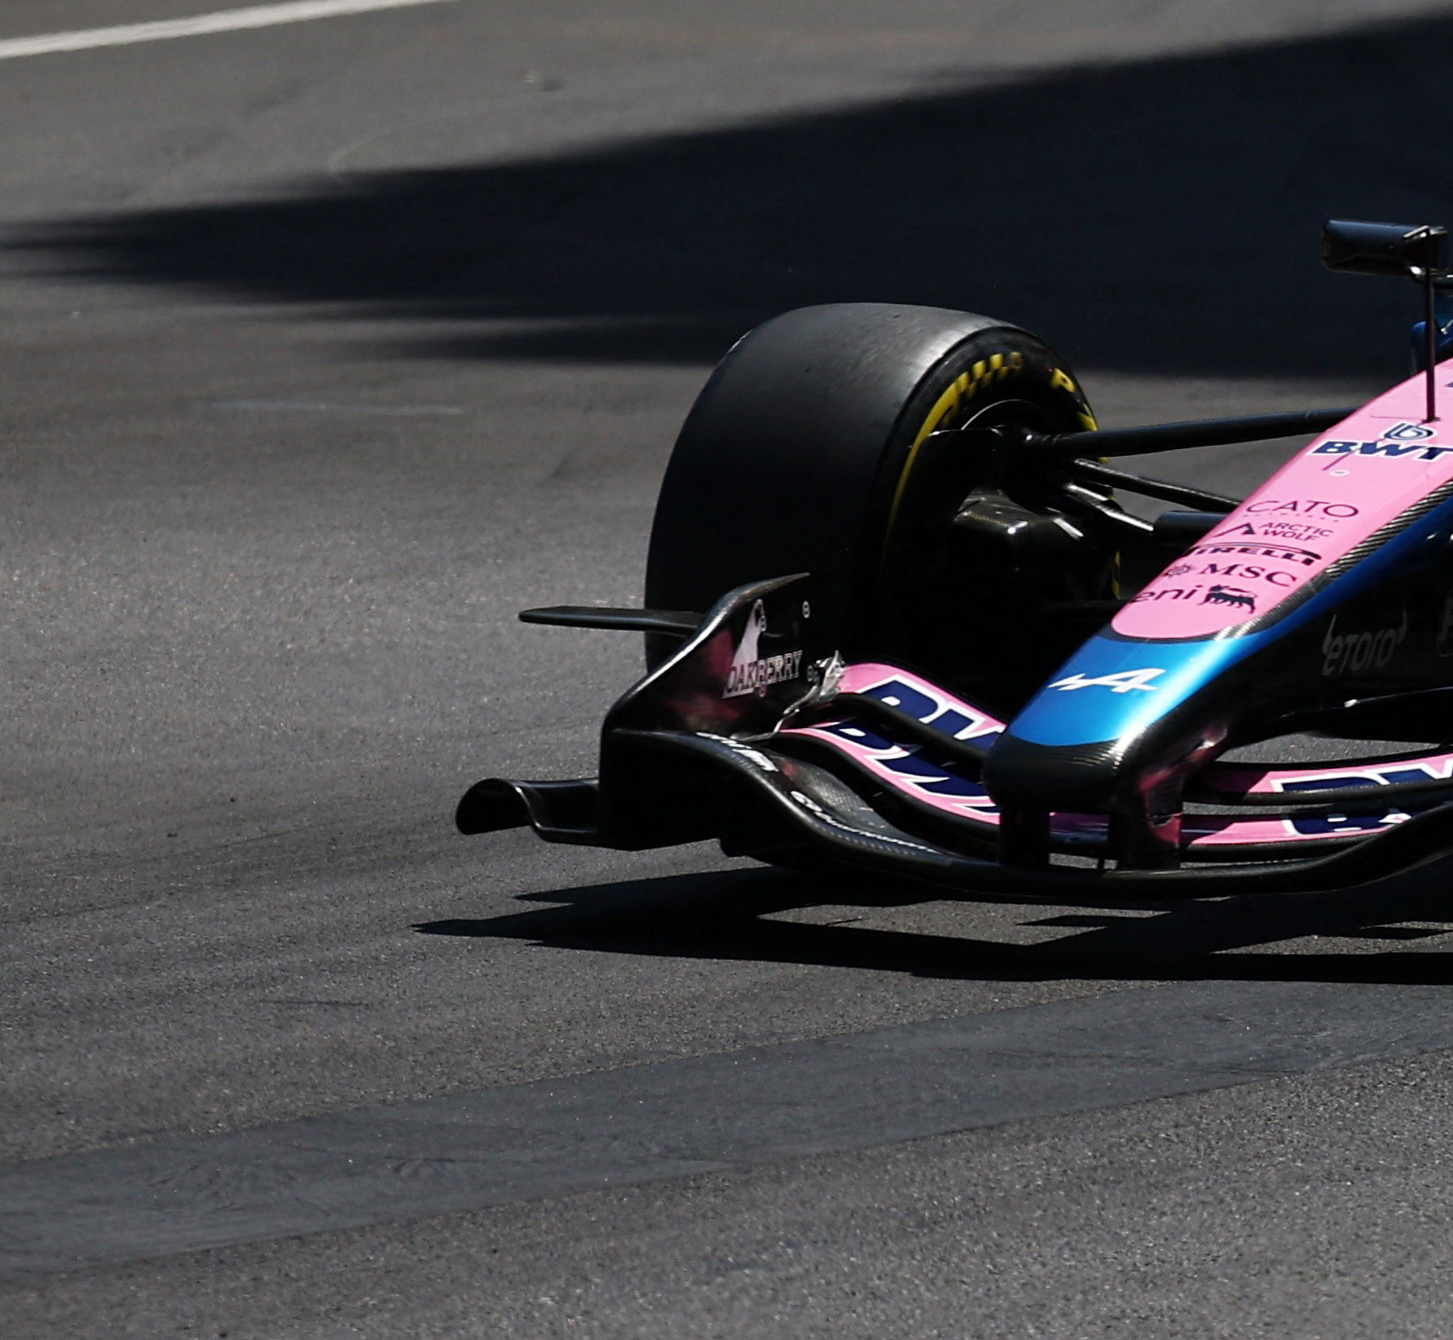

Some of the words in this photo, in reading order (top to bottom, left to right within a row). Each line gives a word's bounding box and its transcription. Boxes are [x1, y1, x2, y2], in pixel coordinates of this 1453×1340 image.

[1245, 499, 1360, 518] CATO
[1260, 521, 1334, 537] ARCTIC
[1262, 529, 1320, 542] WOLF
[1199, 563, 1298, 588] MSC
[1131, 584, 1204, 604] eni
[727, 649, 804, 695] OAKBERRY
